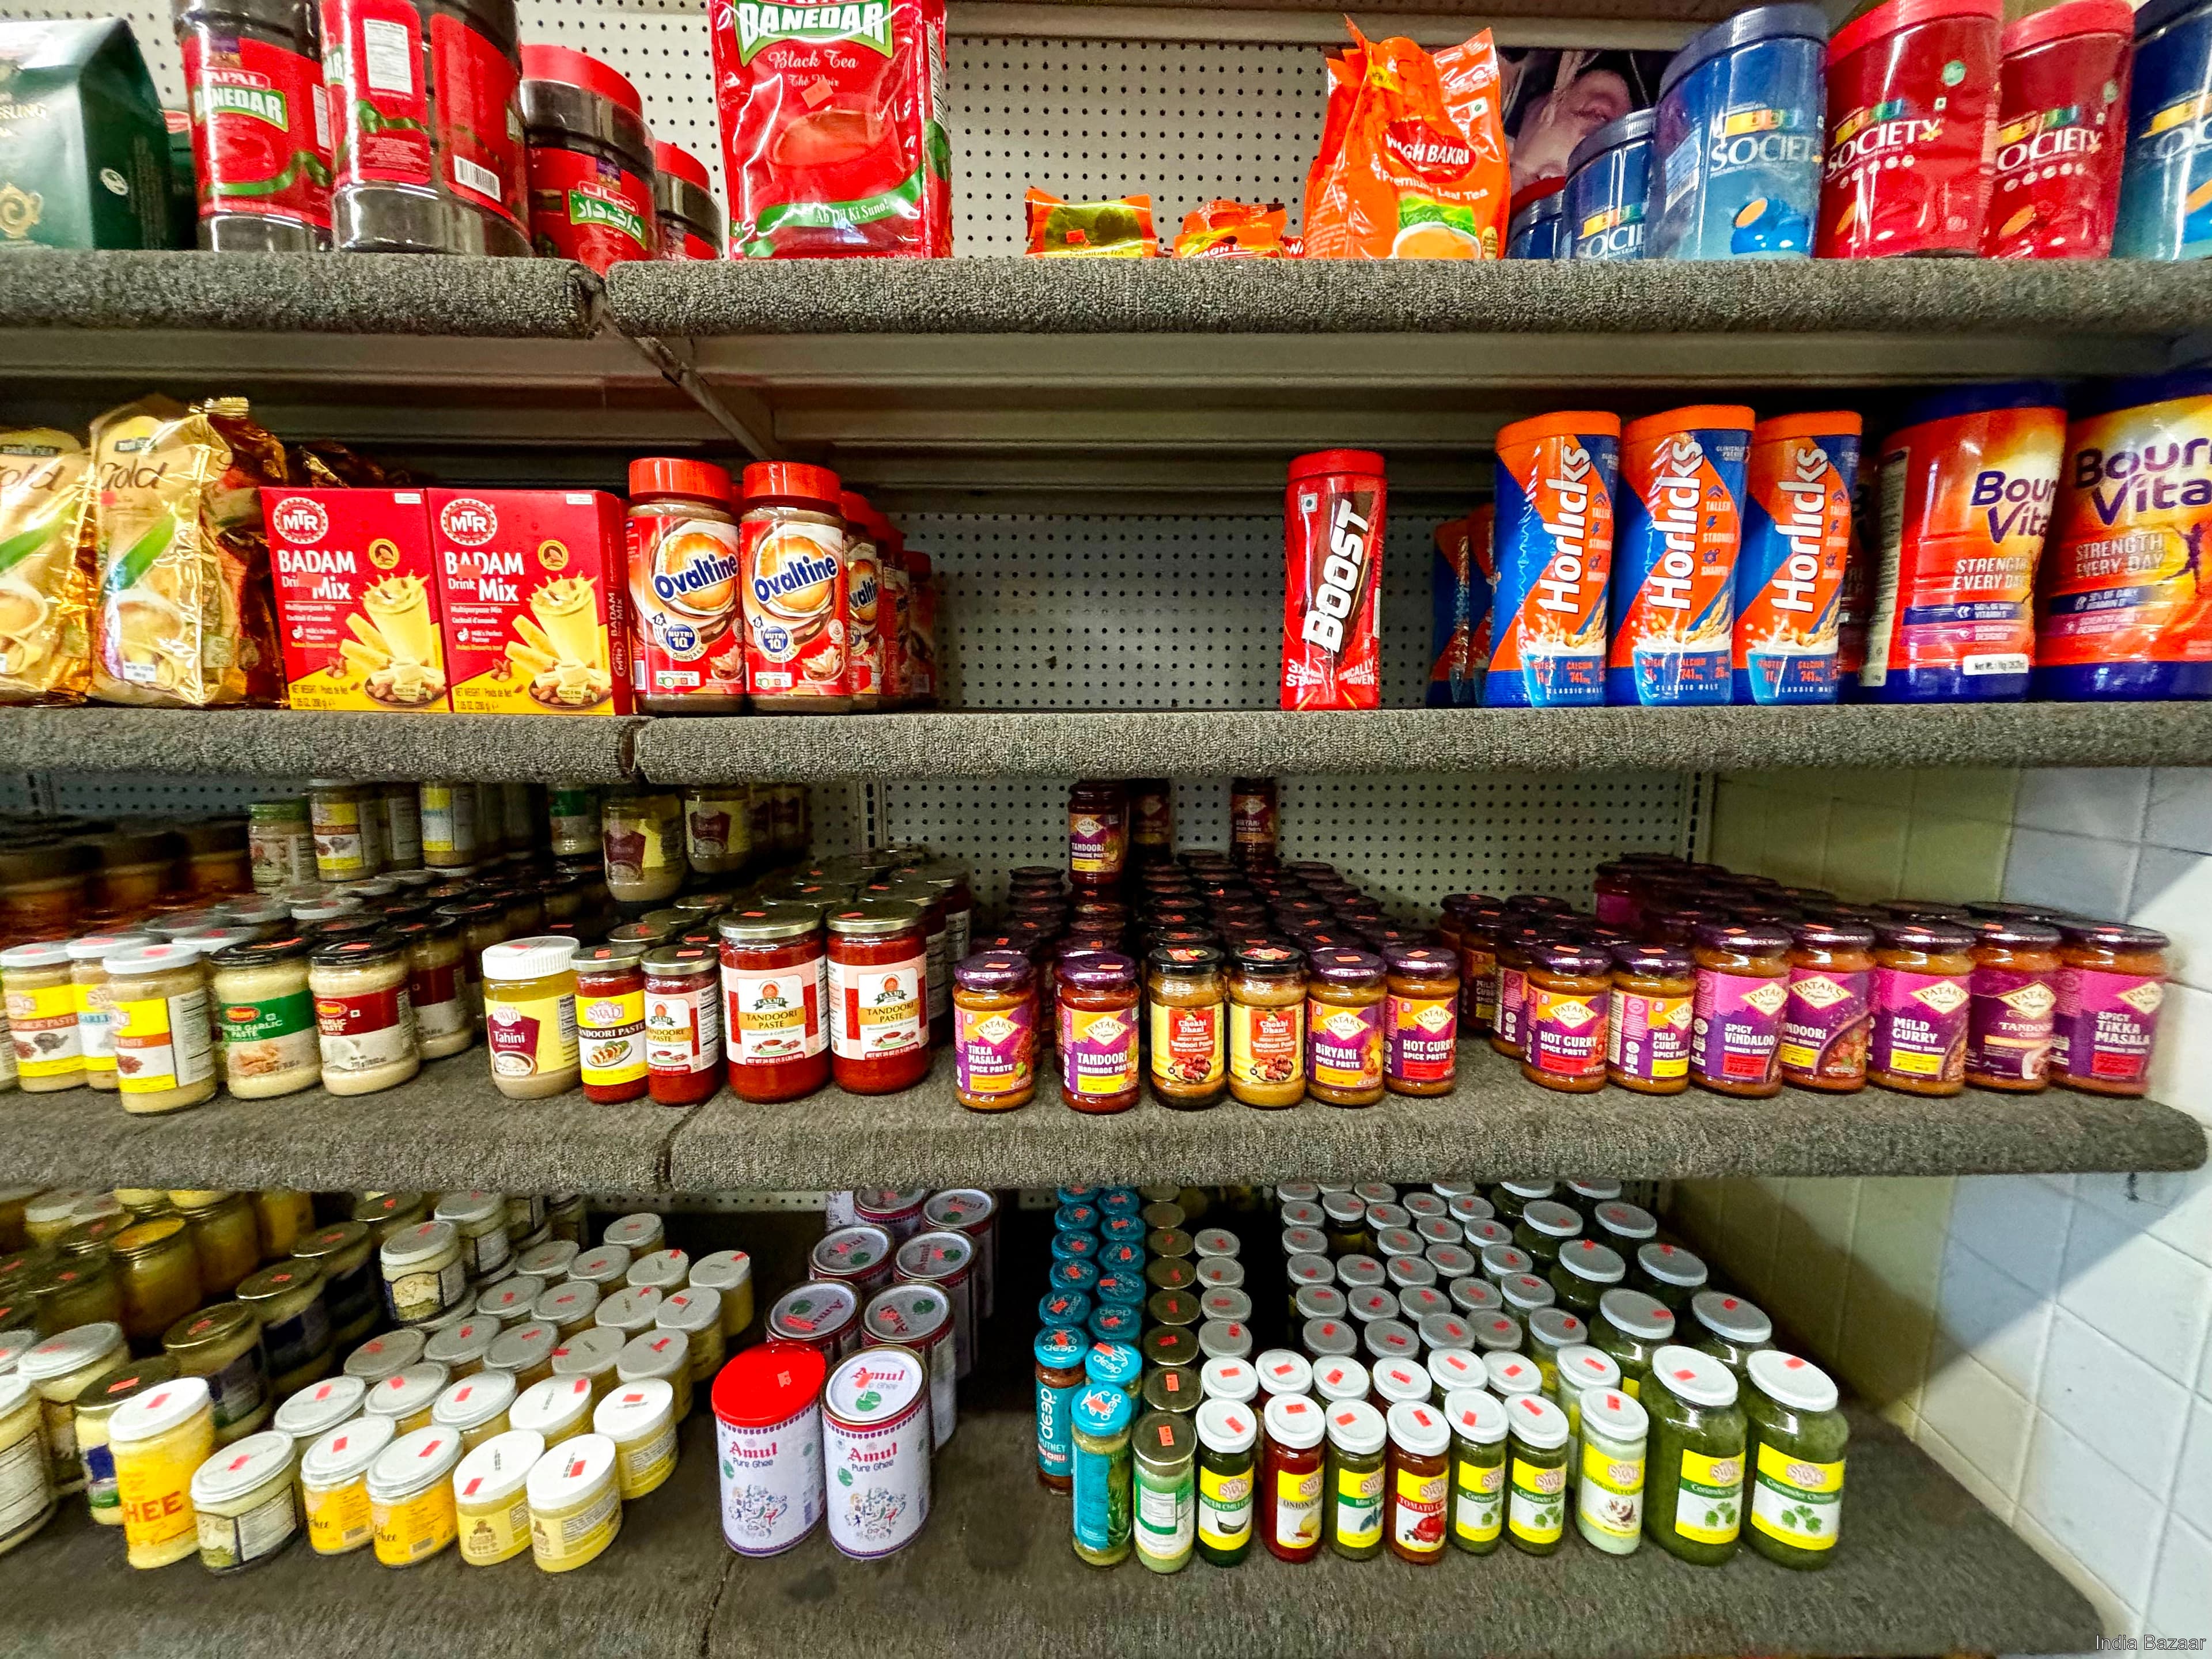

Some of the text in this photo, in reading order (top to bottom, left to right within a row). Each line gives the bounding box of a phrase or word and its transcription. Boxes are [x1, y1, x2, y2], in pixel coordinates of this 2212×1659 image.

[740, 1, 885, 53] DANEDAR
[768, 50, 858, 69] Black Tea
[204, 69, 265, 88] APAL
[194, 87, 283, 124] DNEDAR
[1386, 134, 1470, 165] WAGH BAKRI
[1710, 135, 1814, 171] SOCIET
[1827, 119, 1940, 179] SOCIETY
[1997, 126, 2104, 173] OCIETY
[1381, 169, 1488, 201] Premium Leaf Tea
[815, 209, 829, 223] Ab
[849, 206, 860, 220] Ki
[861, 198, 889, 218] Suno!
[1575, 224, 1643, 259] SOCI
[2075, 438, 2212, 488] Bour
[99, 459, 169, 491] Gold
[1970, 470, 2057, 507] Bour
[1706, 501, 1731, 512] TALLER
[2091, 475, 2212, 526] Vita
[283, 509, 319, 532] MTR
[450, 510, 487, 532] MTR
[1537, 444, 1592, 614] Horlicks
[1647, 441, 1704, 611] Horlicks
[1770, 446, 1829, 613] Horlicks
[2075, 533, 2165, 563] STRENGTH
[276, 550, 357, 574] BADAM
[444, 551, 525, 575] BADAM
[2076, 553, 2164, 579] EVERY DAY
[654, 553, 738, 600] Ovaltine
[753, 554, 838, 603] Ovaltine
[1301, 498, 1369, 653] BOOST
[1952, 574, 2002, 590] EVERY
[312, 575, 352, 600] Mix
[448, 577, 519, 602] Drink Mix
[588, 1008, 622, 1020] SWAD
[746, 1009, 798, 1021] TANDOORI
[866, 1001, 914, 1016] TANDOORI
[879, 1013, 903, 1023] PASTE
[578, 1021, 645, 1039] NDOORI PASTE
[758, 1020, 785, 1029] PASTE
[1891, 1028, 1938, 1044] CURRY
[494, 1030, 525, 1044] Tahini
[1403, 1039, 1455, 1052] HOT CURRY
[1540, 1031, 1597, 1048] HOT CURRY
[1653, 1040, 1681, 1050] CURRY
[968, 1055, 1003, 1065] MASALA
[1043, 1344, 1077, 1353] deep
[851, 1366, 906, 1382] Amul
[1093, 1355, 1122, 1375] deep
[1040, 1388, 1054, 1440] deep
[729, 1441, 778, 1459] Amul
[847, 1441, 899, 1463] Amul
[1042, 1441, 1066, 1453] UTNEY
[733, 1458, 774, 1468] Pure Ghee
[851, 1459, 895, 1472] Pure Ghee
[123, 1490, 183, 1522] HEE
[1399, 1495, 1436, 1511] TOMATO
